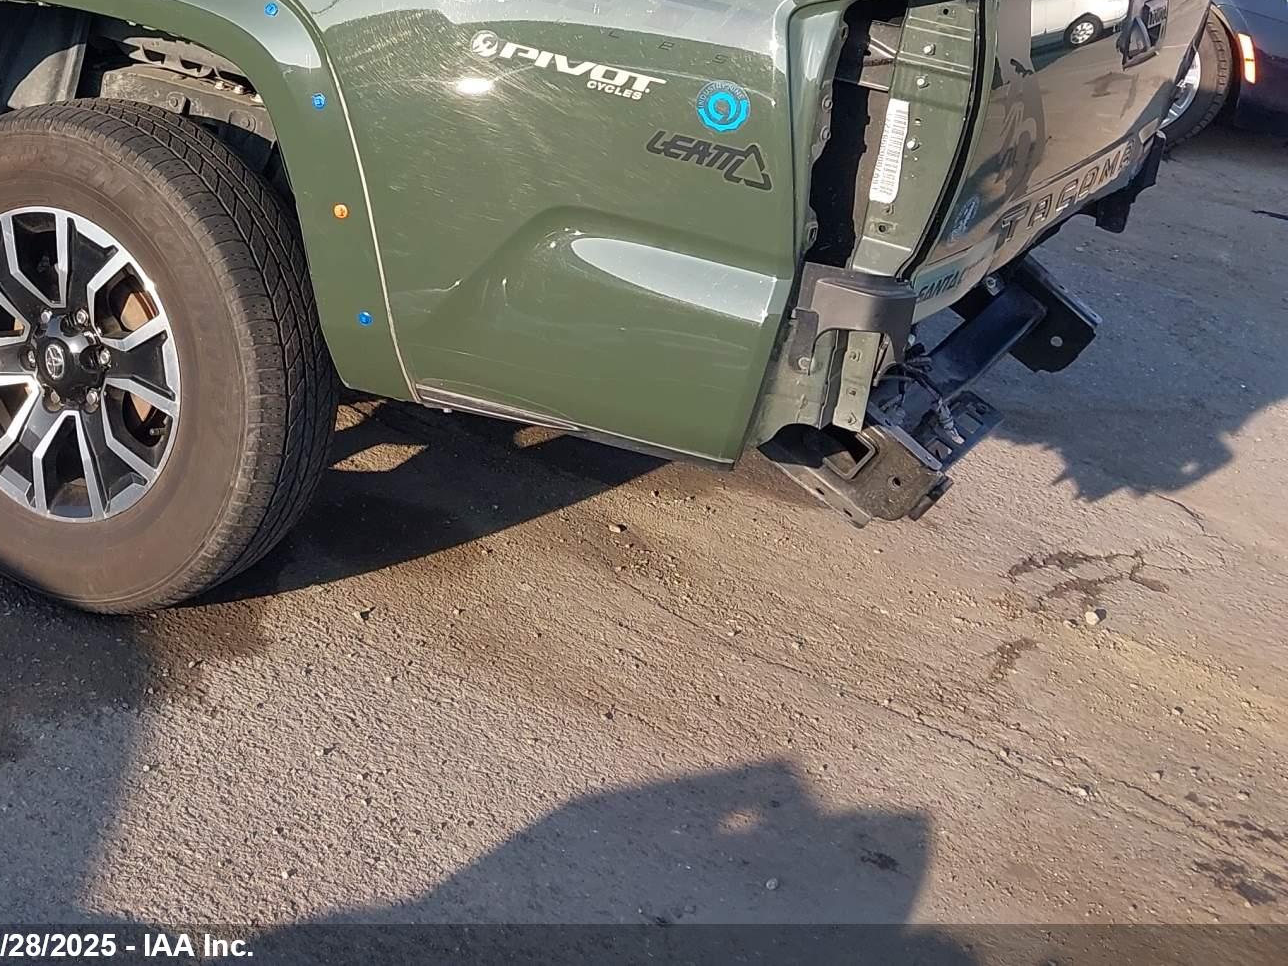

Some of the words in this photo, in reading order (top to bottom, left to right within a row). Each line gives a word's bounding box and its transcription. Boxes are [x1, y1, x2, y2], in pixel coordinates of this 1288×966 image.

[499, 41, 667, 93] PIVOT
[586, 79, 643, 101] CYCLES
[996, 137, 1136, 245] TACOMA
